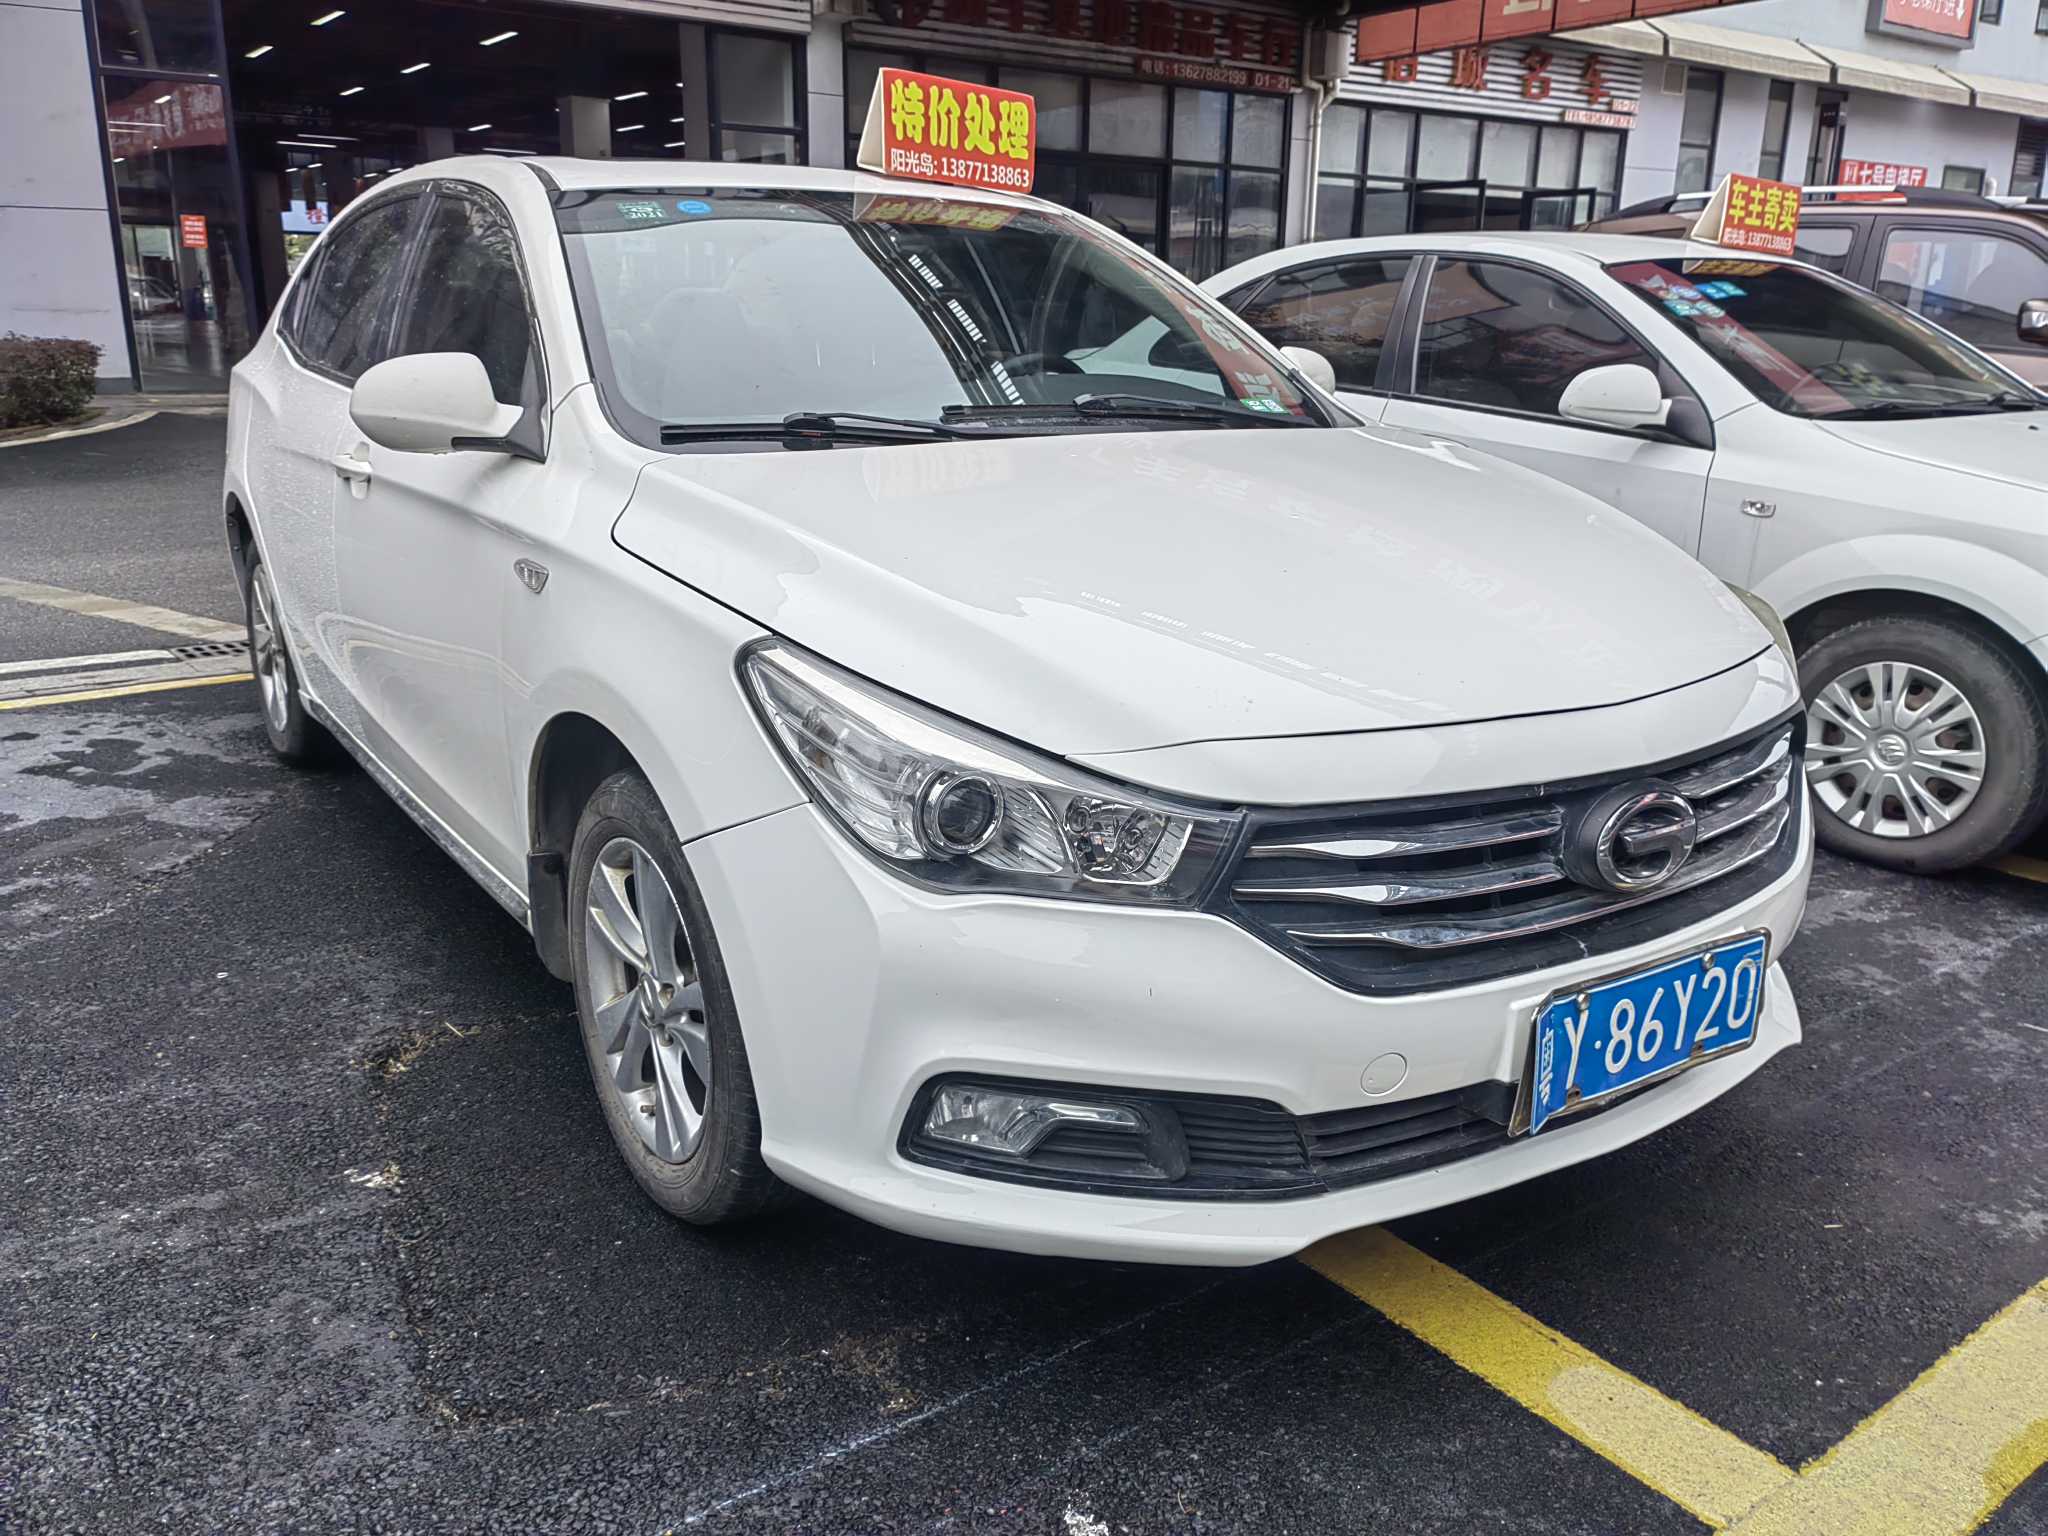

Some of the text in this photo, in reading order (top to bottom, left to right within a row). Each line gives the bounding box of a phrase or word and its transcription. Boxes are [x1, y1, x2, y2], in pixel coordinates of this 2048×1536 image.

[890, 78, 1030, 160] 特价处理
[1728, 179, 1798, 233] 车主寄卖
